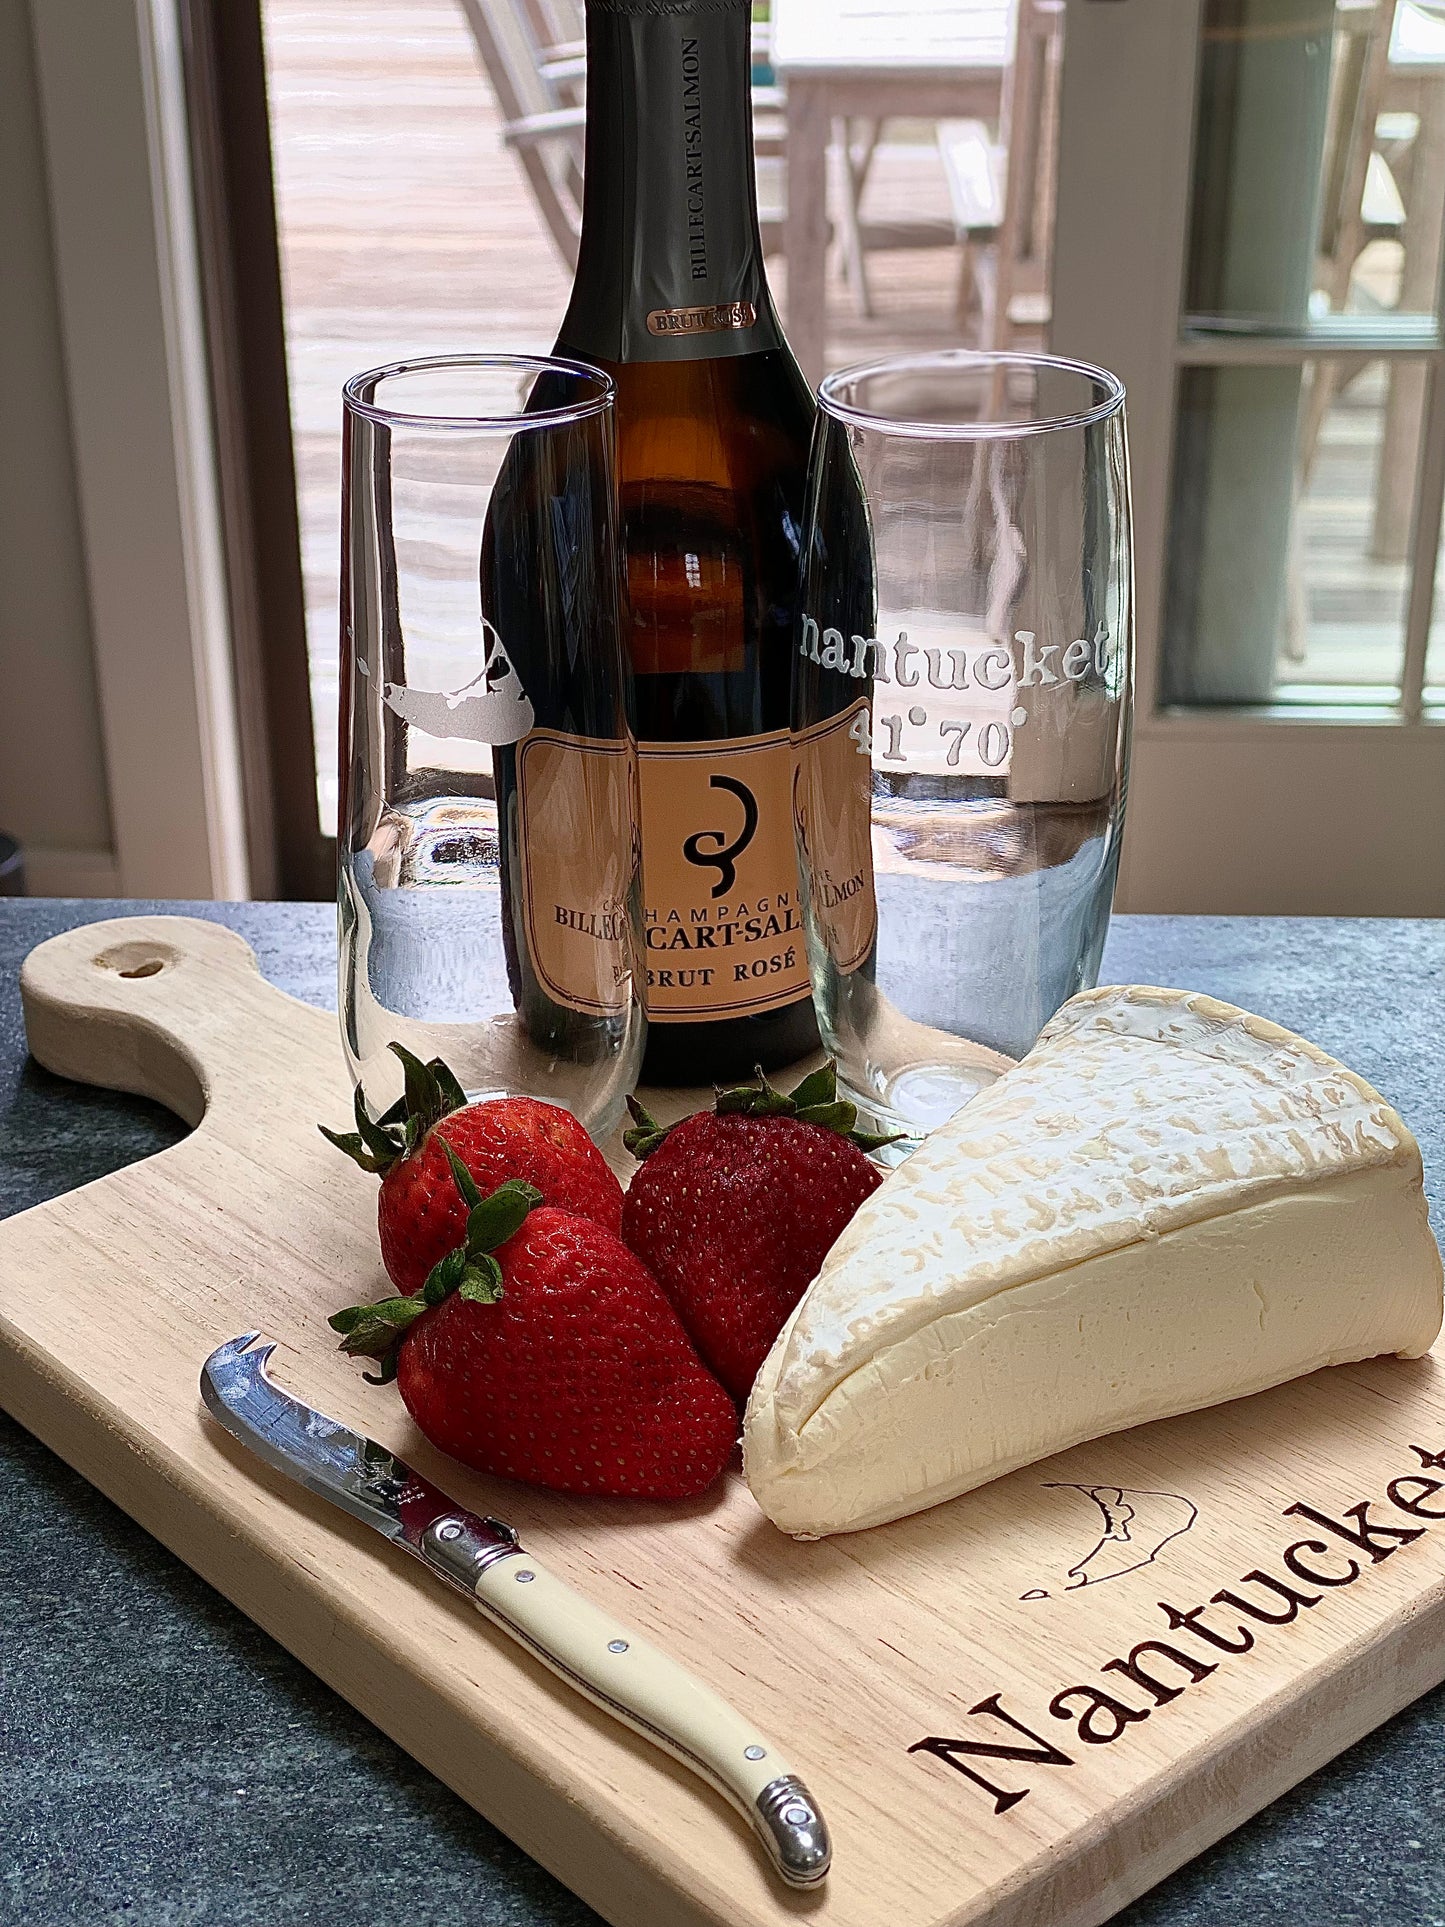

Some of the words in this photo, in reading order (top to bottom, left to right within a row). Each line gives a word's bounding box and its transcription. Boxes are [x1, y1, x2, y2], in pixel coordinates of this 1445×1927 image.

[681, 38, 708, 281] BILLECART-SALMON
[655, 313, 706, 331] BRUT
[801, 613, 1110, 691] nantucket
[646, 968, 715, 988] BRUT
[733, 945, 797, 983] ROSÉ
